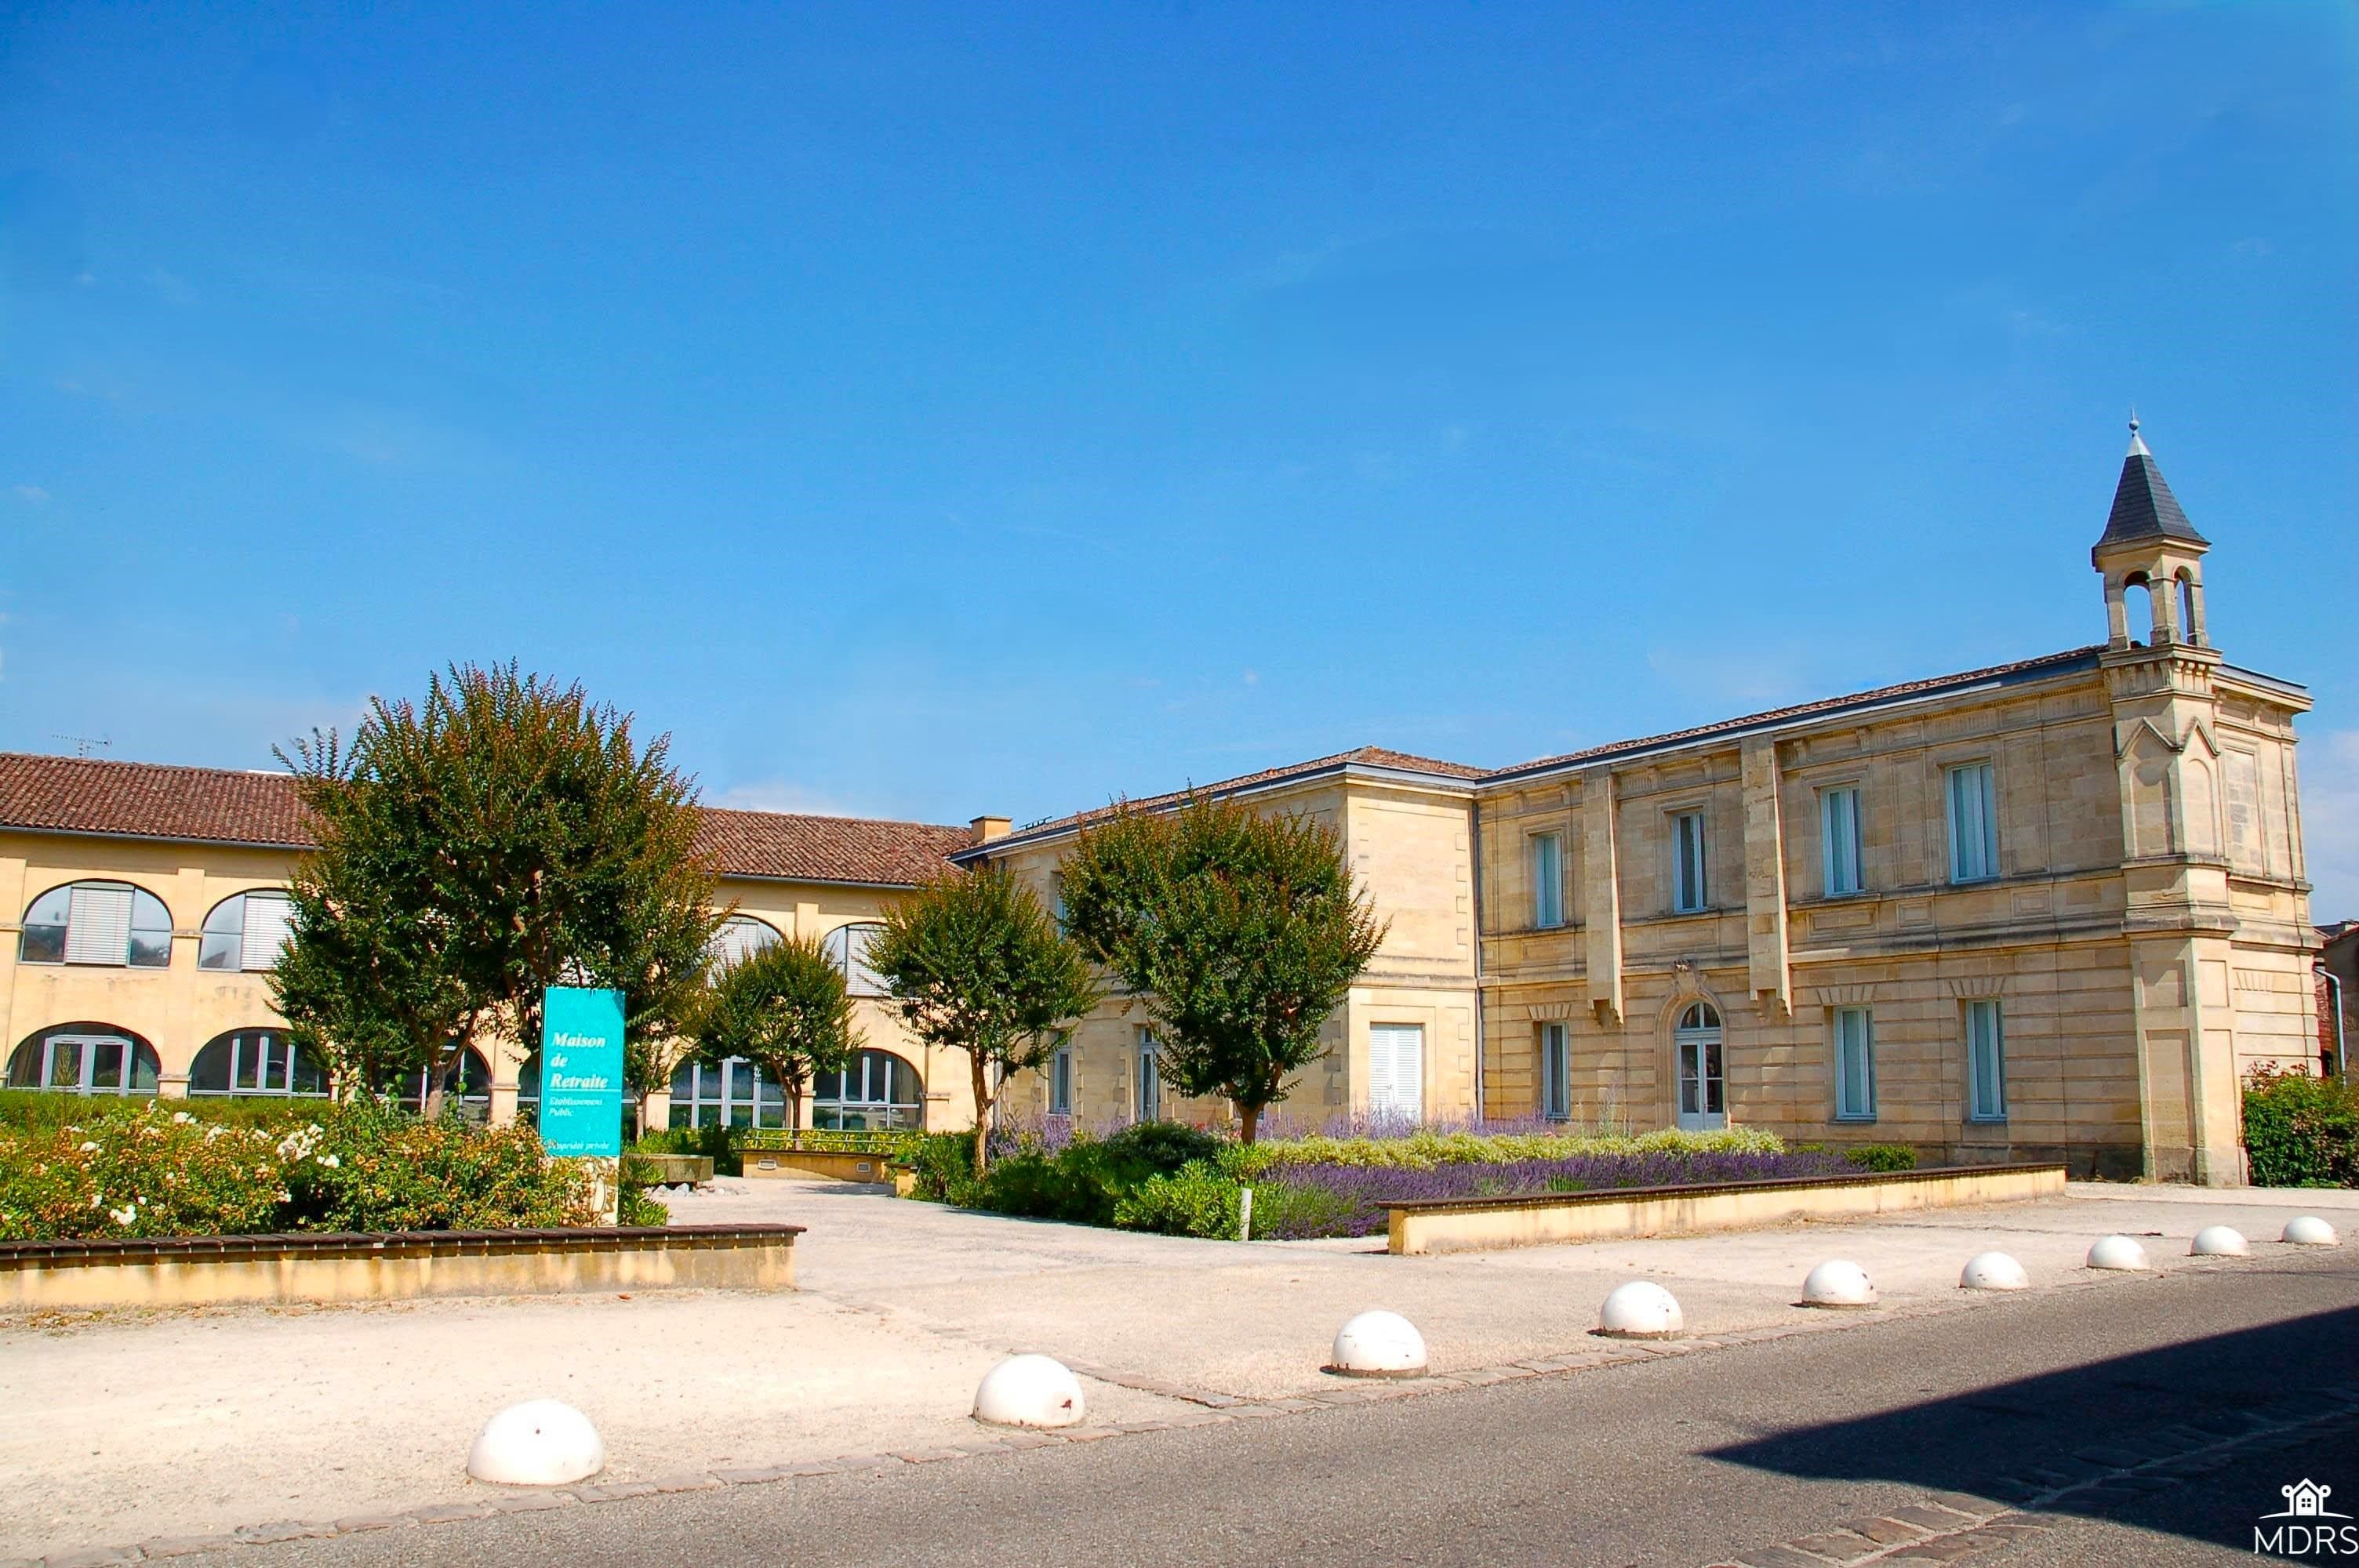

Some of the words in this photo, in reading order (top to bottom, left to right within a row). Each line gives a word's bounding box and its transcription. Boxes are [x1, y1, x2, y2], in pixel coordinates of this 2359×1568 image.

[552, 1033, 605, 1047] Maison
[551, 1053, 568, 1068] de
[551, 1073, 608, 1088] Retraite
[549, 1107, 572, 1116] Public
